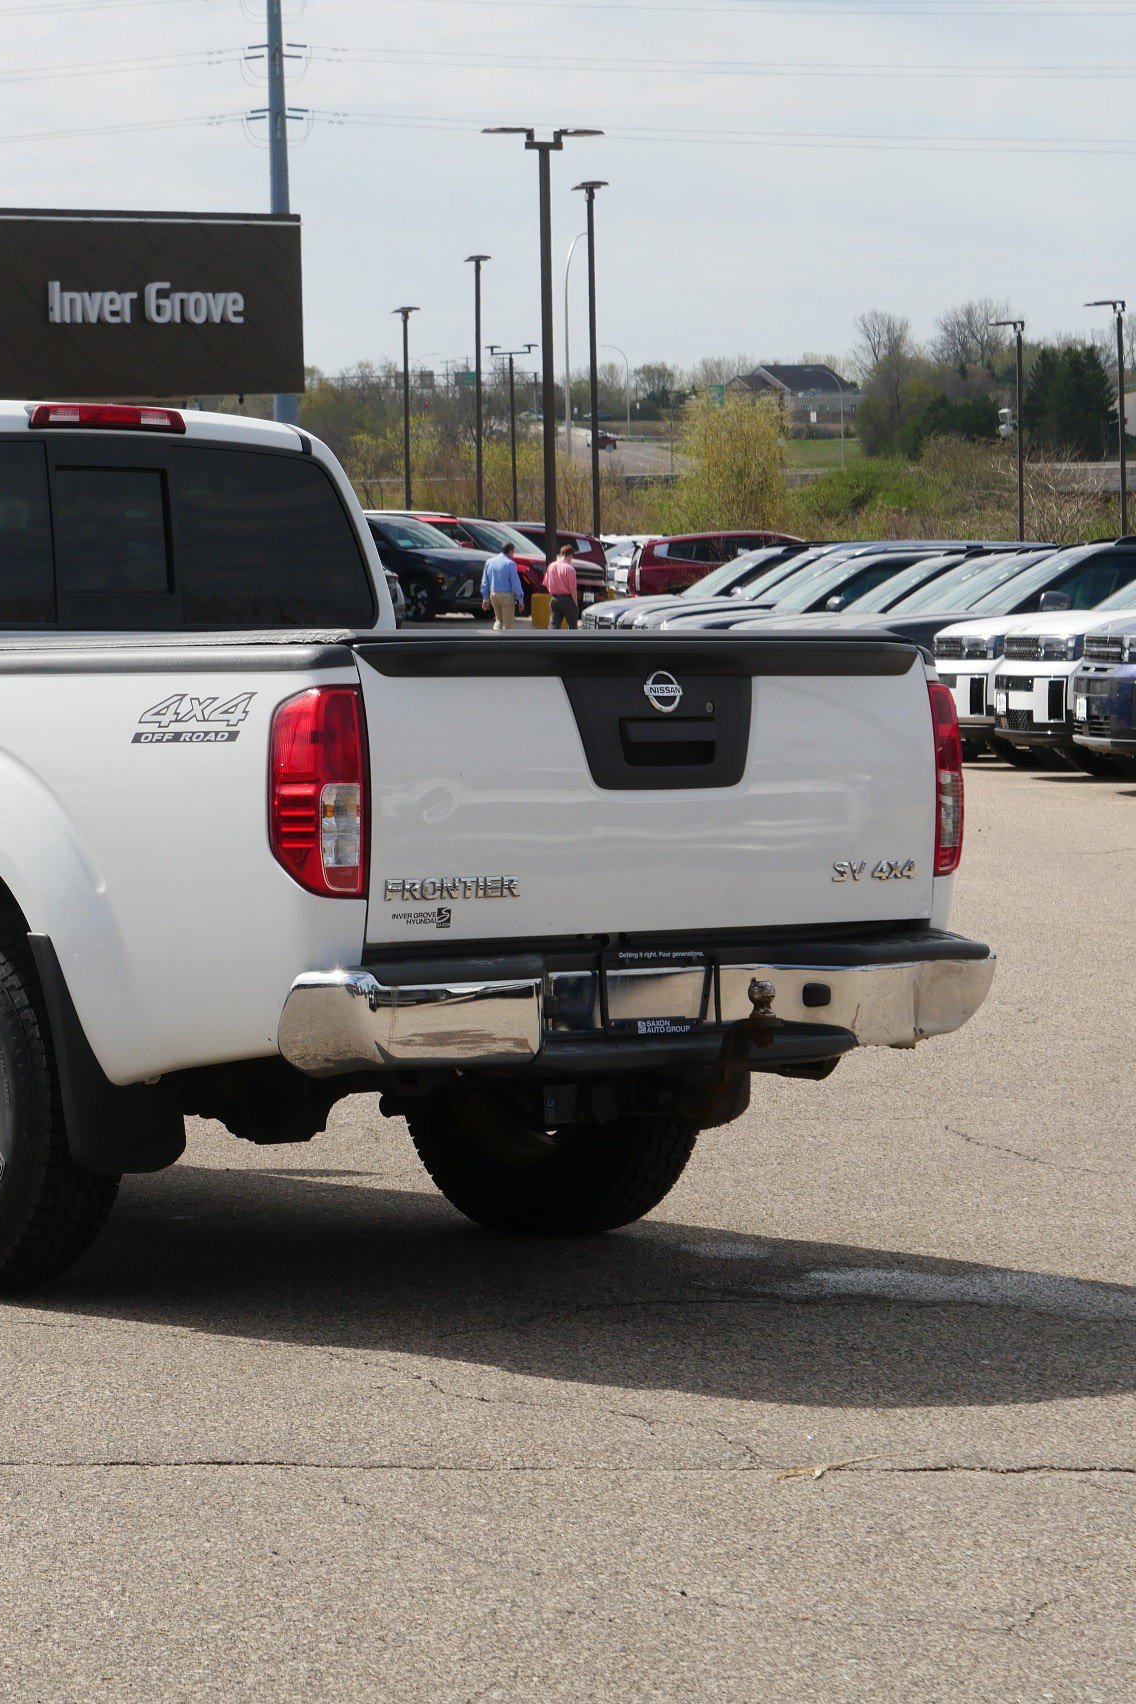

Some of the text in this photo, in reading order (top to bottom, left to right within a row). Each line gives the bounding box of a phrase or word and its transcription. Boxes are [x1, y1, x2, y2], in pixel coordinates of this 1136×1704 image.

[48, 280, 245, 324] Inver Grove
[649, 686, 680, 694] NISSAN
[140, 731, 229, 743] OFF ROAD
[831, 860, 867, 882] SV
[384, 875, 520, 901] FRONTIER
[391, 911, 437, 920] INVER GROVE
[618, 951, 639, 959] Getting
[644, 951, 658, 959] right.
[672, 950, 705, 959] generations.
[646, 1019, 670, 1027] SAXON
[646, 1025, 691, 1034] AUTO GROUP
